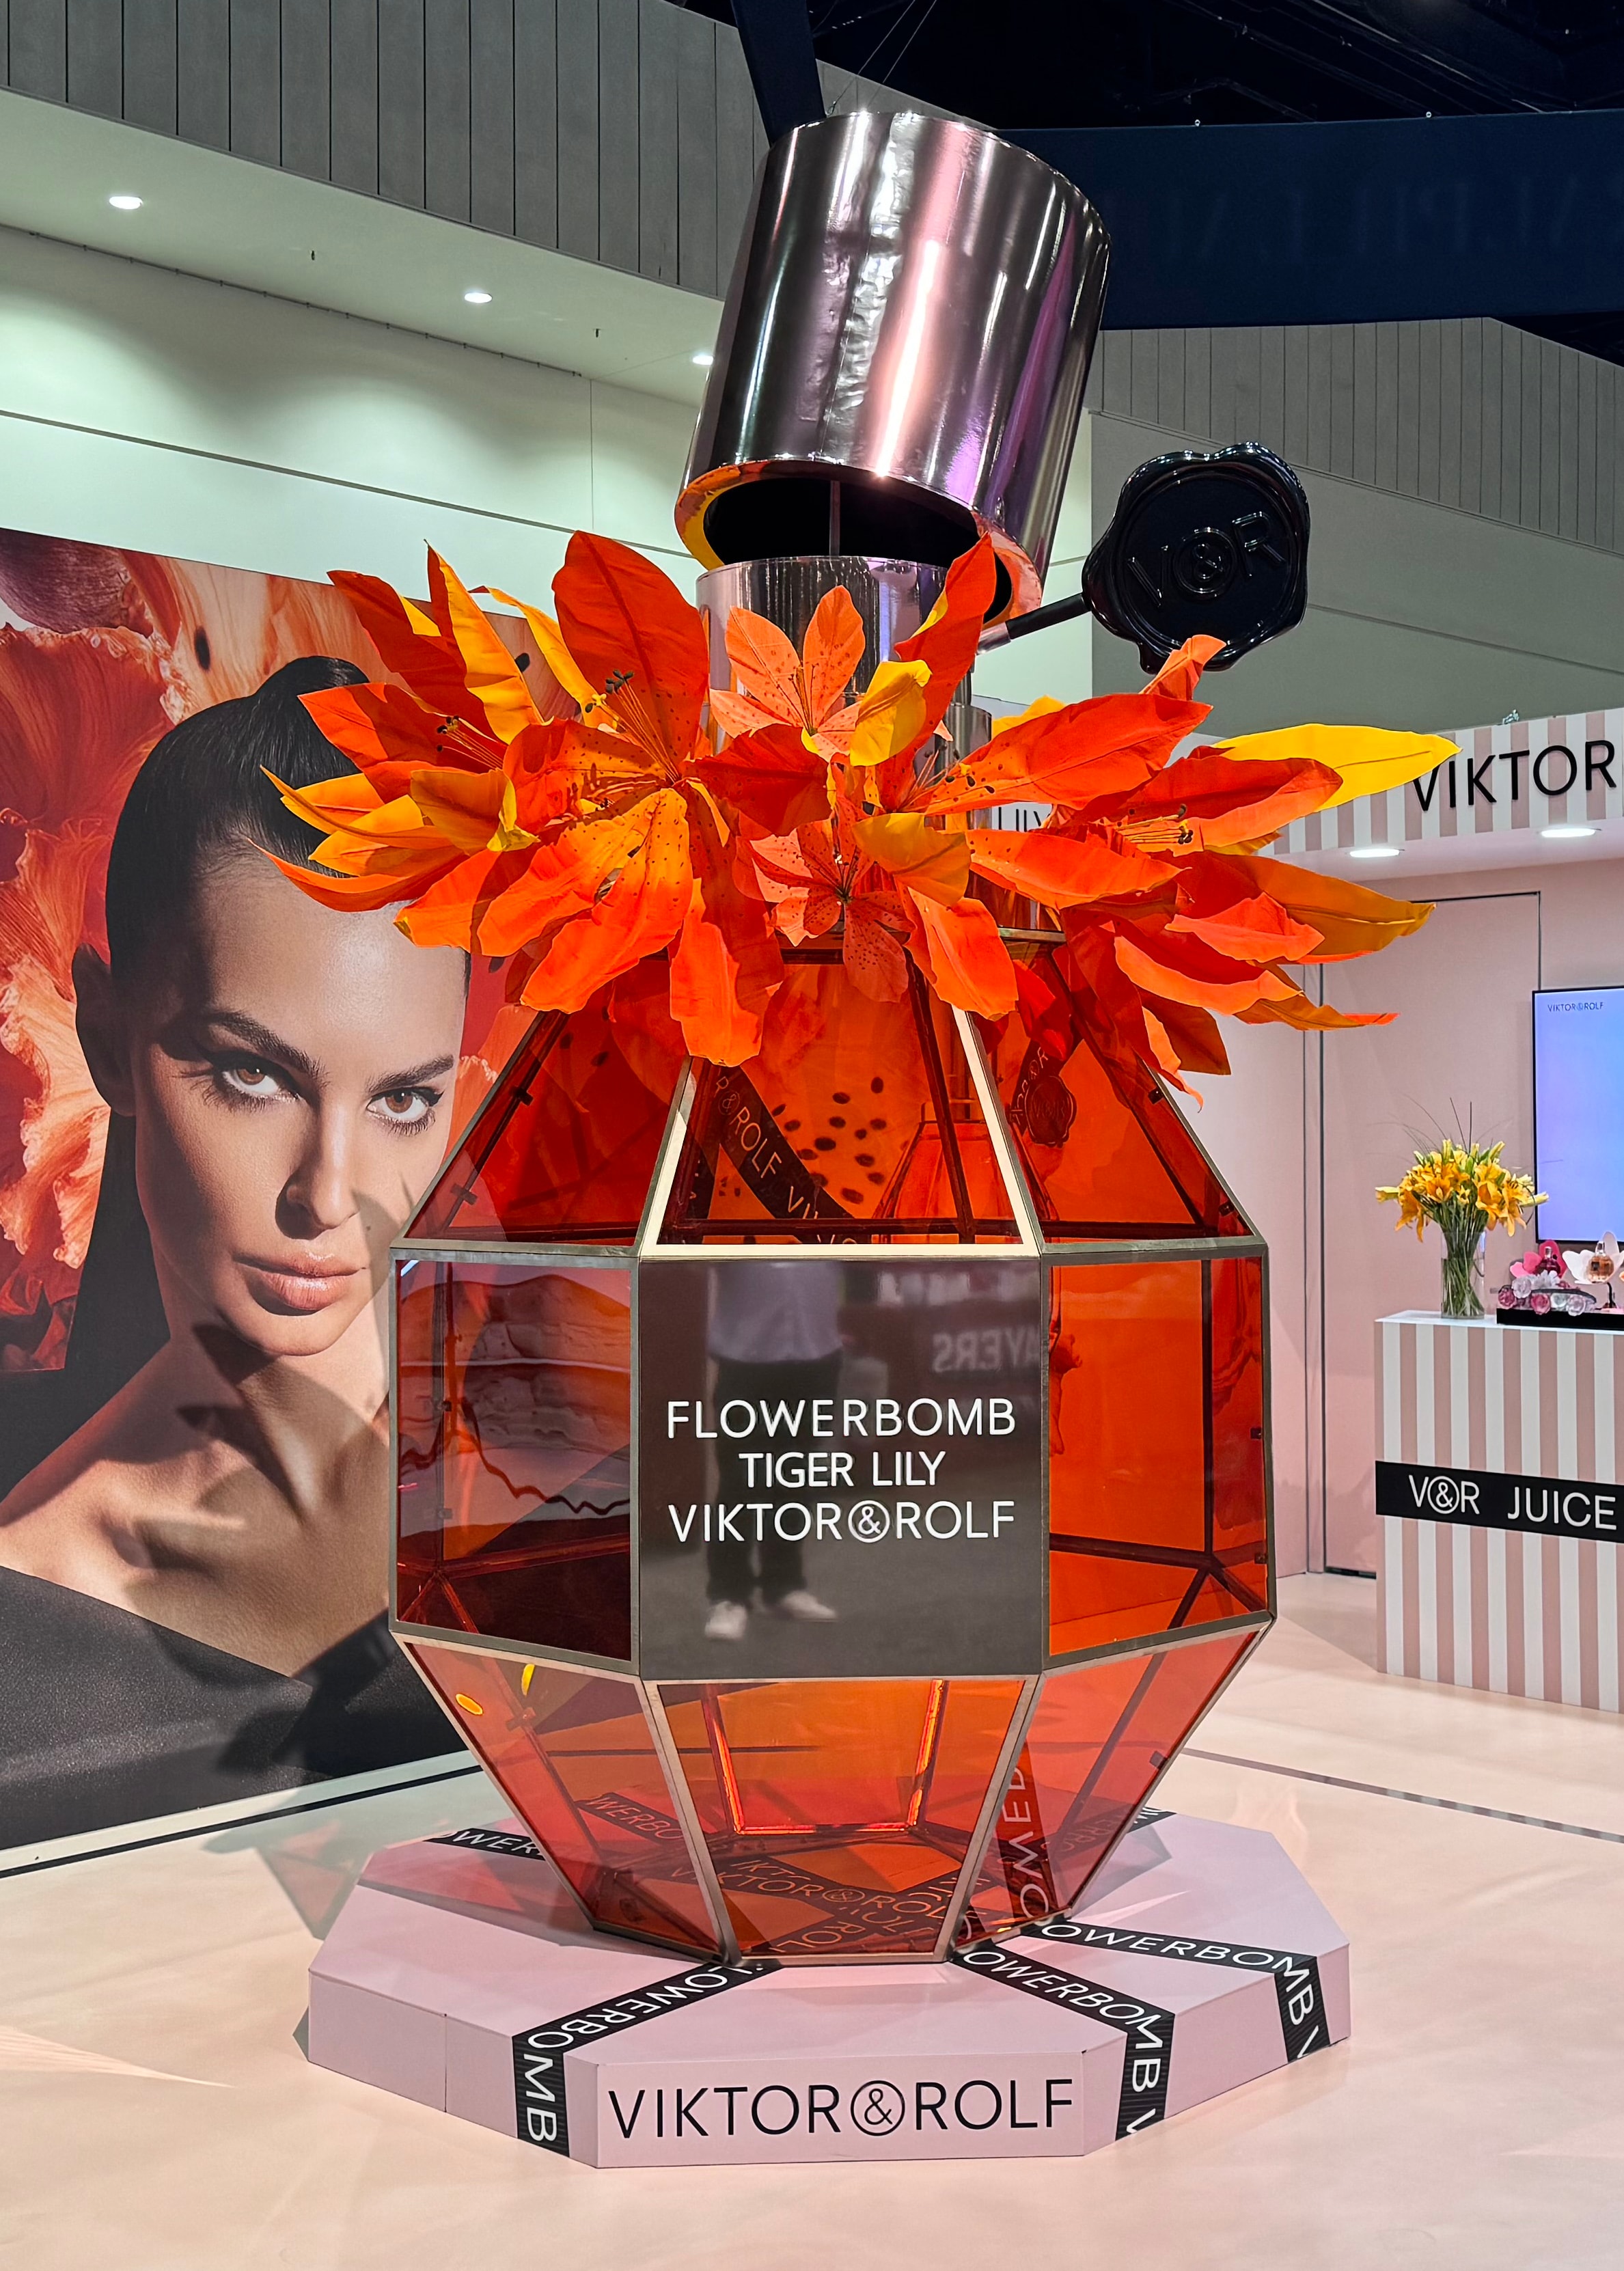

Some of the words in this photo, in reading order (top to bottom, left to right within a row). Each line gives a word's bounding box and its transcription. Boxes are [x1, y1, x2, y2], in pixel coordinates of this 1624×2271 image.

[1412, 740, 1617, 812] VIKTOR
[714, 1067, 782, 1179] R&ROLF
[667, 1397, 1017, 1439] FLOWERBOMB
[739, 1451, 854, 1489] TIGER
[872, 1450, 946, 1487] LILY
[668, 1500, 1015, 1543] VIKTOR&ROLF
[1408, 1474, 1480, 1515] V&R
[1507, 1486, 1617, 1530] JUICE
[441, 1830, 542, 1856] WER
[523, 1965, 764, 2142] LOWERBOMB
[607, 2078, 1073, 2139] VIKTOR&ROLF
